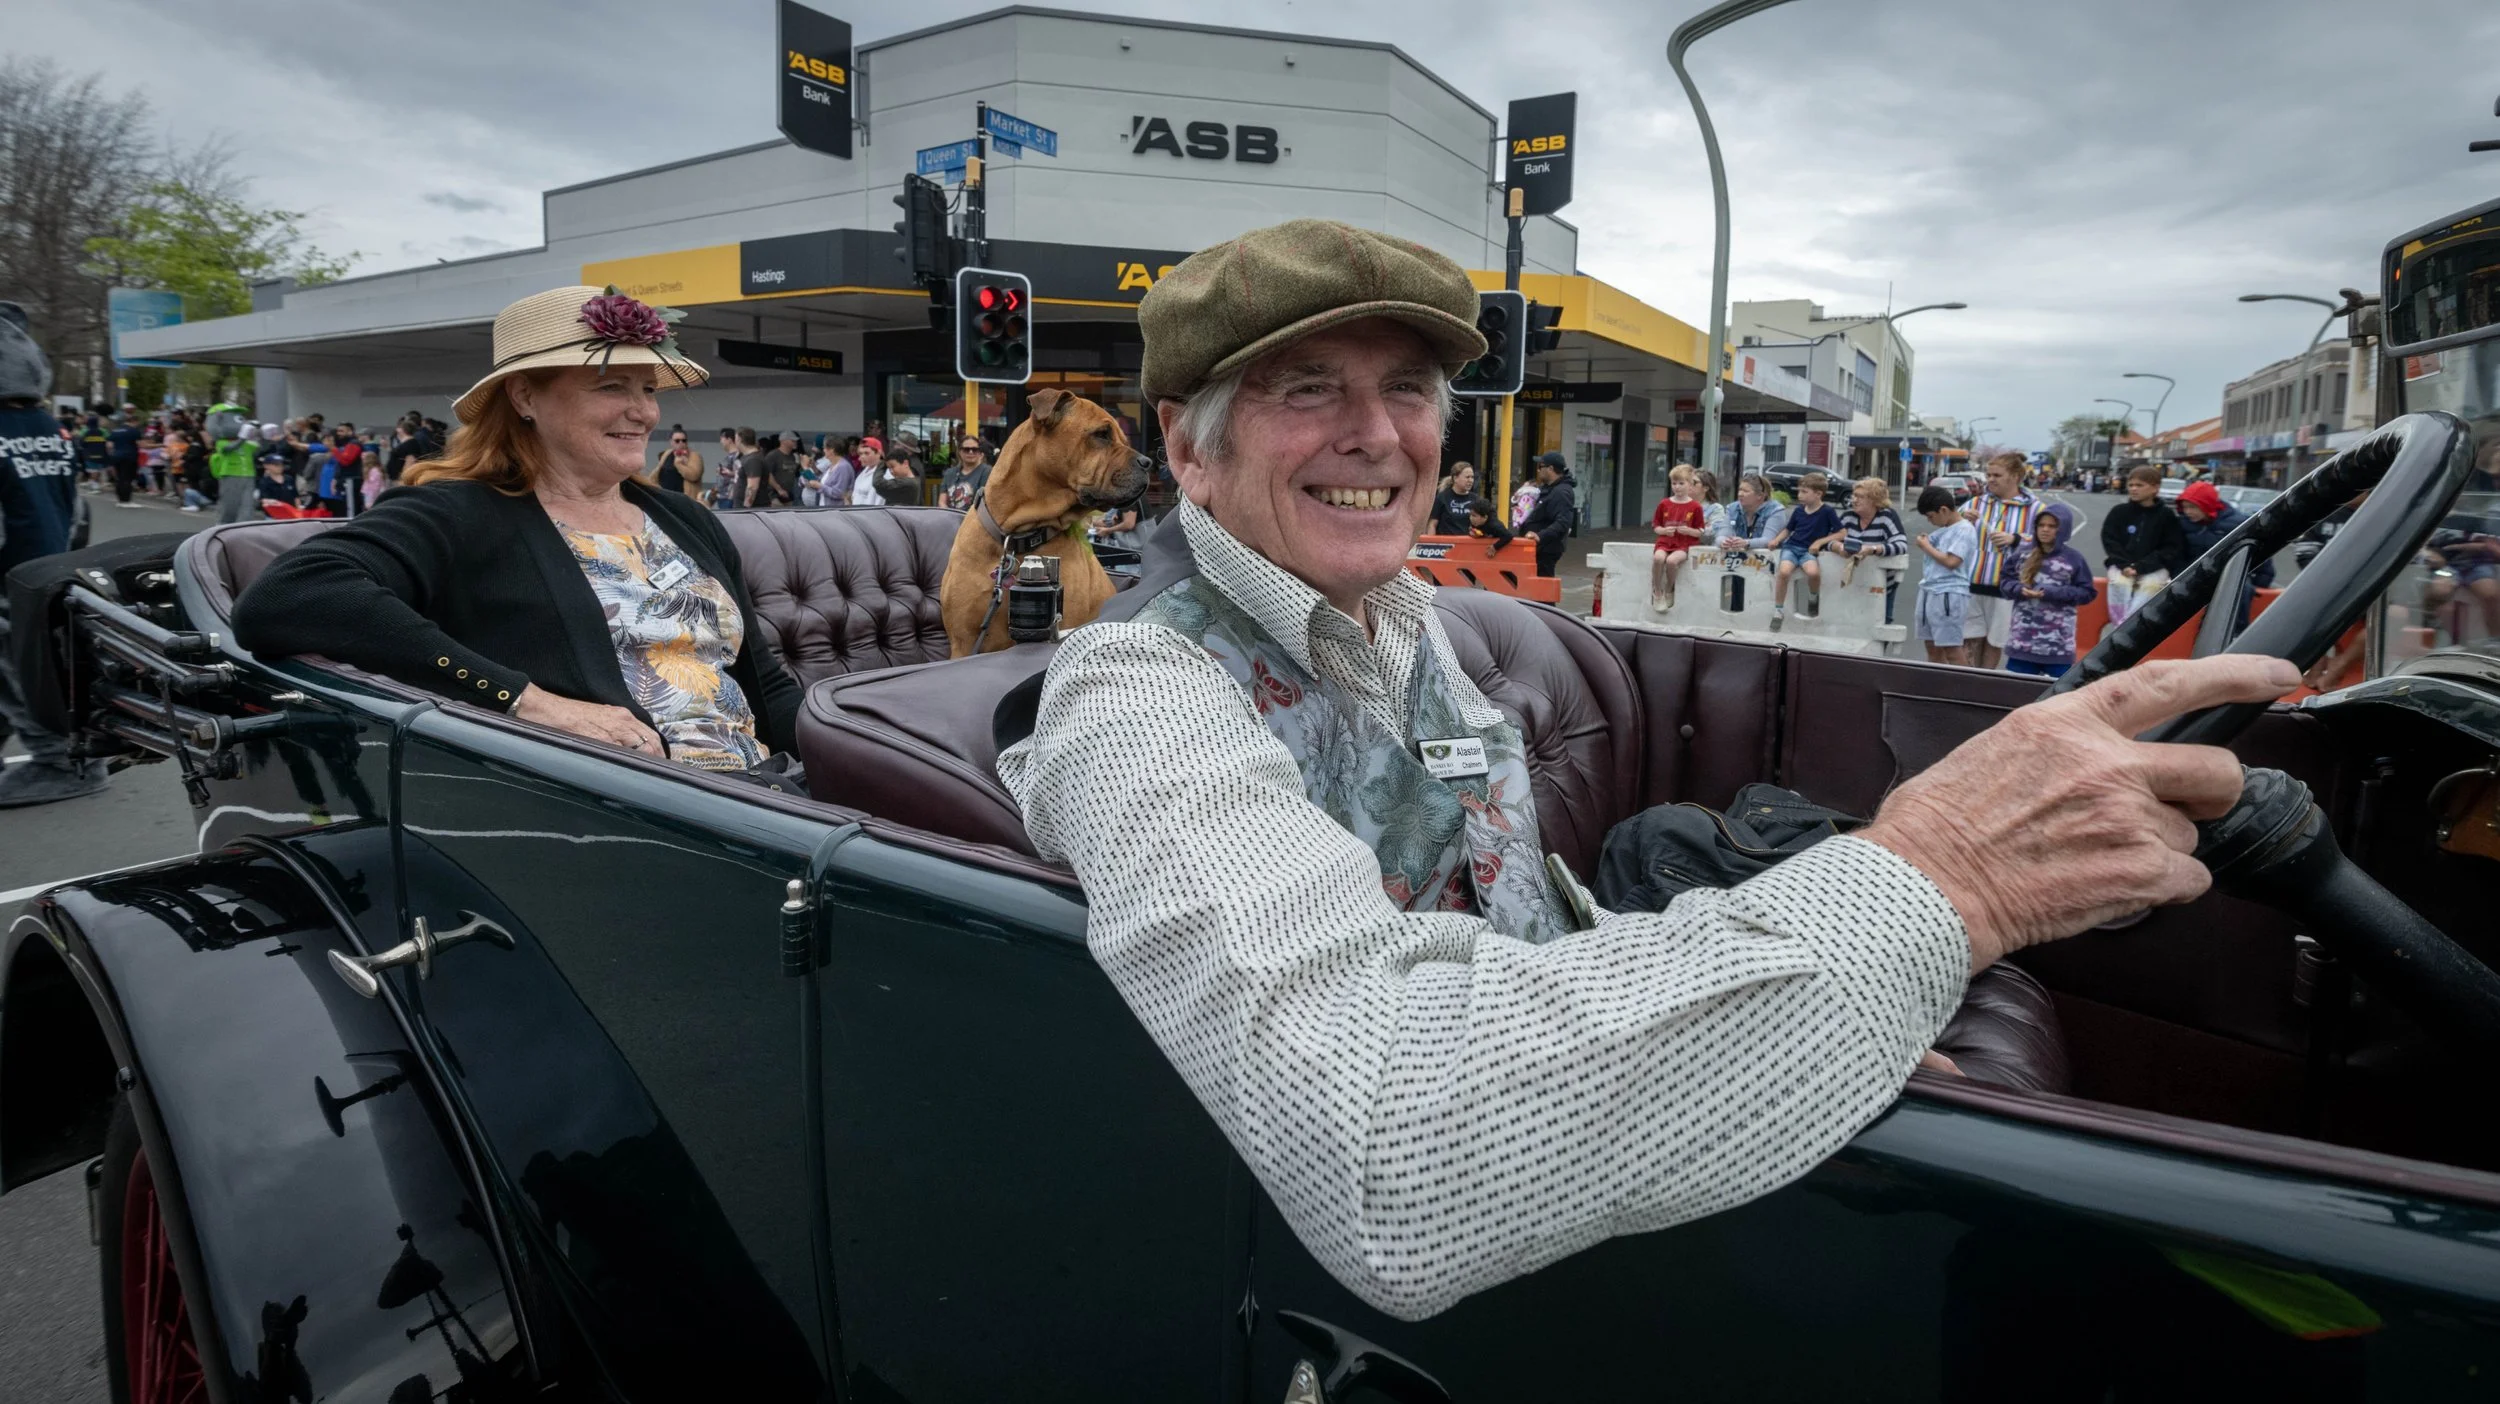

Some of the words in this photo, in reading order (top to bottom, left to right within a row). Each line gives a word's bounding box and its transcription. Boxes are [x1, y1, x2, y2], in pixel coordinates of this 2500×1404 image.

[788, 50, 845, 85] ASB
[803, 85, 831, 106] Bank
[991, 111, 1029, 138] Market
[1036, 130, 1048, 145] St
[1132, 115, 1279, 164] ASB
[1513, 135, 1566, 155] ASB
[925, 148, 957, 165] Queen
[962, 142, 973, 157] St
[1524, 161, 1551, 175] Bank
[752, 269, 786, 284] Hastings
[797, 355, 833, 369] ASB
[1520, 390, 1553, 399] ASB
[0, 434, 74, 460] Proerty
[1456, 745, 1481, 757] Alastair
